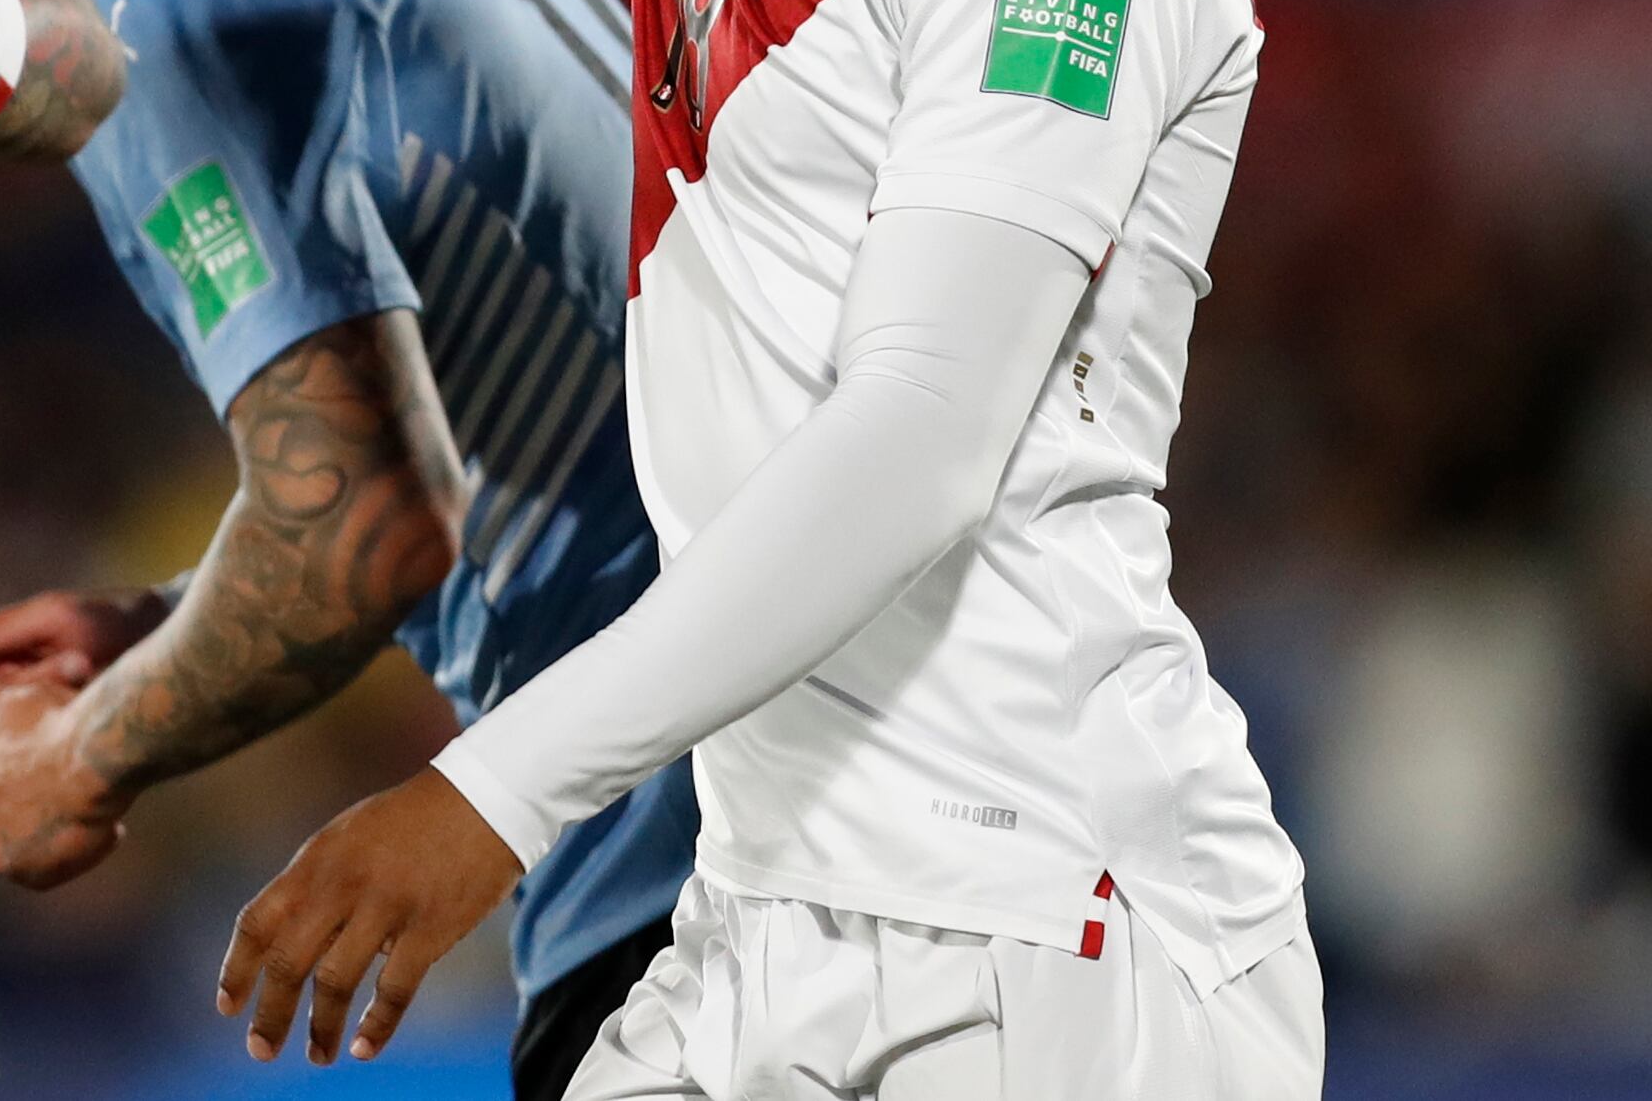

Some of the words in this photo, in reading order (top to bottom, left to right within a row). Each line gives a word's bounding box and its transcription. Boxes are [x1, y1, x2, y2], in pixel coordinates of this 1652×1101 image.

[1004, 5, 1114, 45] FOOTBALL
[1068, 49, 1108, 78] FIFA
[931, 798, 1017, 830] HIDROTEC
